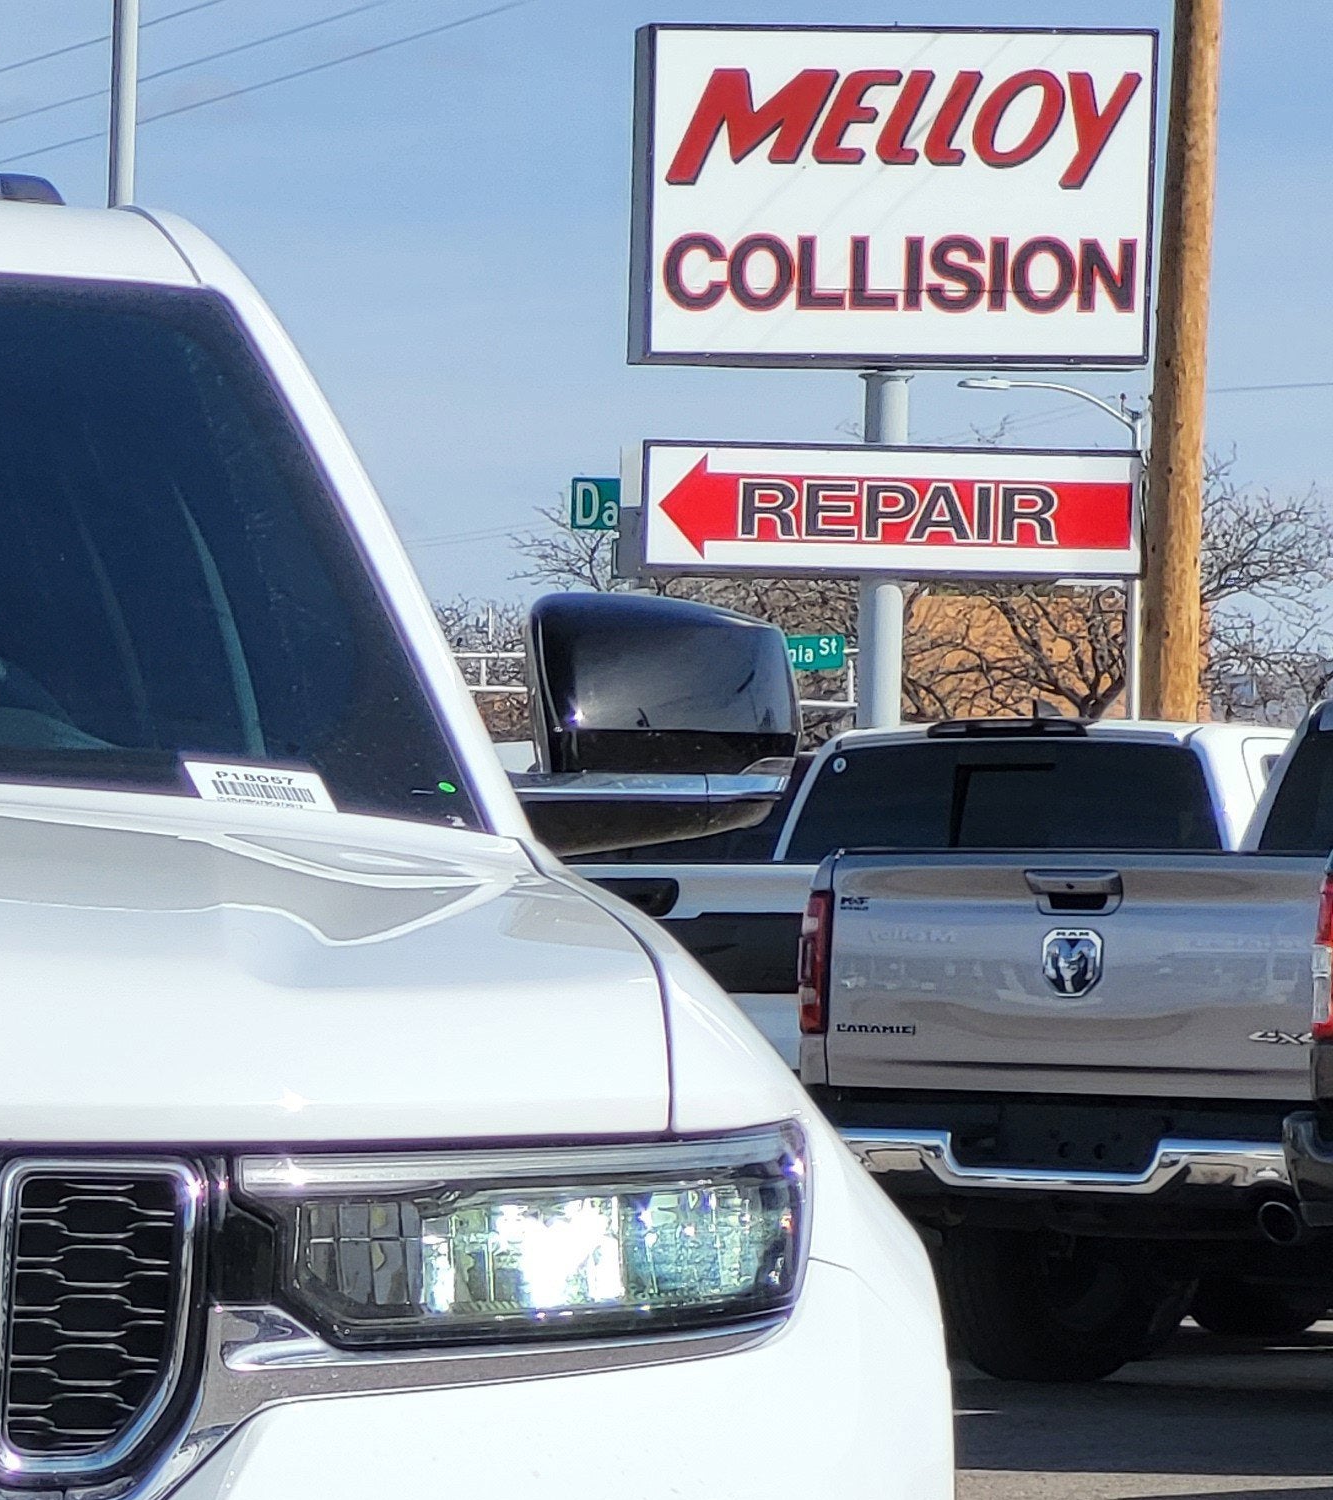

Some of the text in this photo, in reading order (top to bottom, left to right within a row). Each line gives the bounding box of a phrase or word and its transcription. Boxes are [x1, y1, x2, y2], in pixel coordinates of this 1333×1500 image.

[665, 67, 1142, 189] MELLOY
[662, 233, 1138, 314] COLLISION
[575, 481, 619, 527] Da
[737, 478, 1058, 546] REPAIR
[819, 638, 837, 655] St
